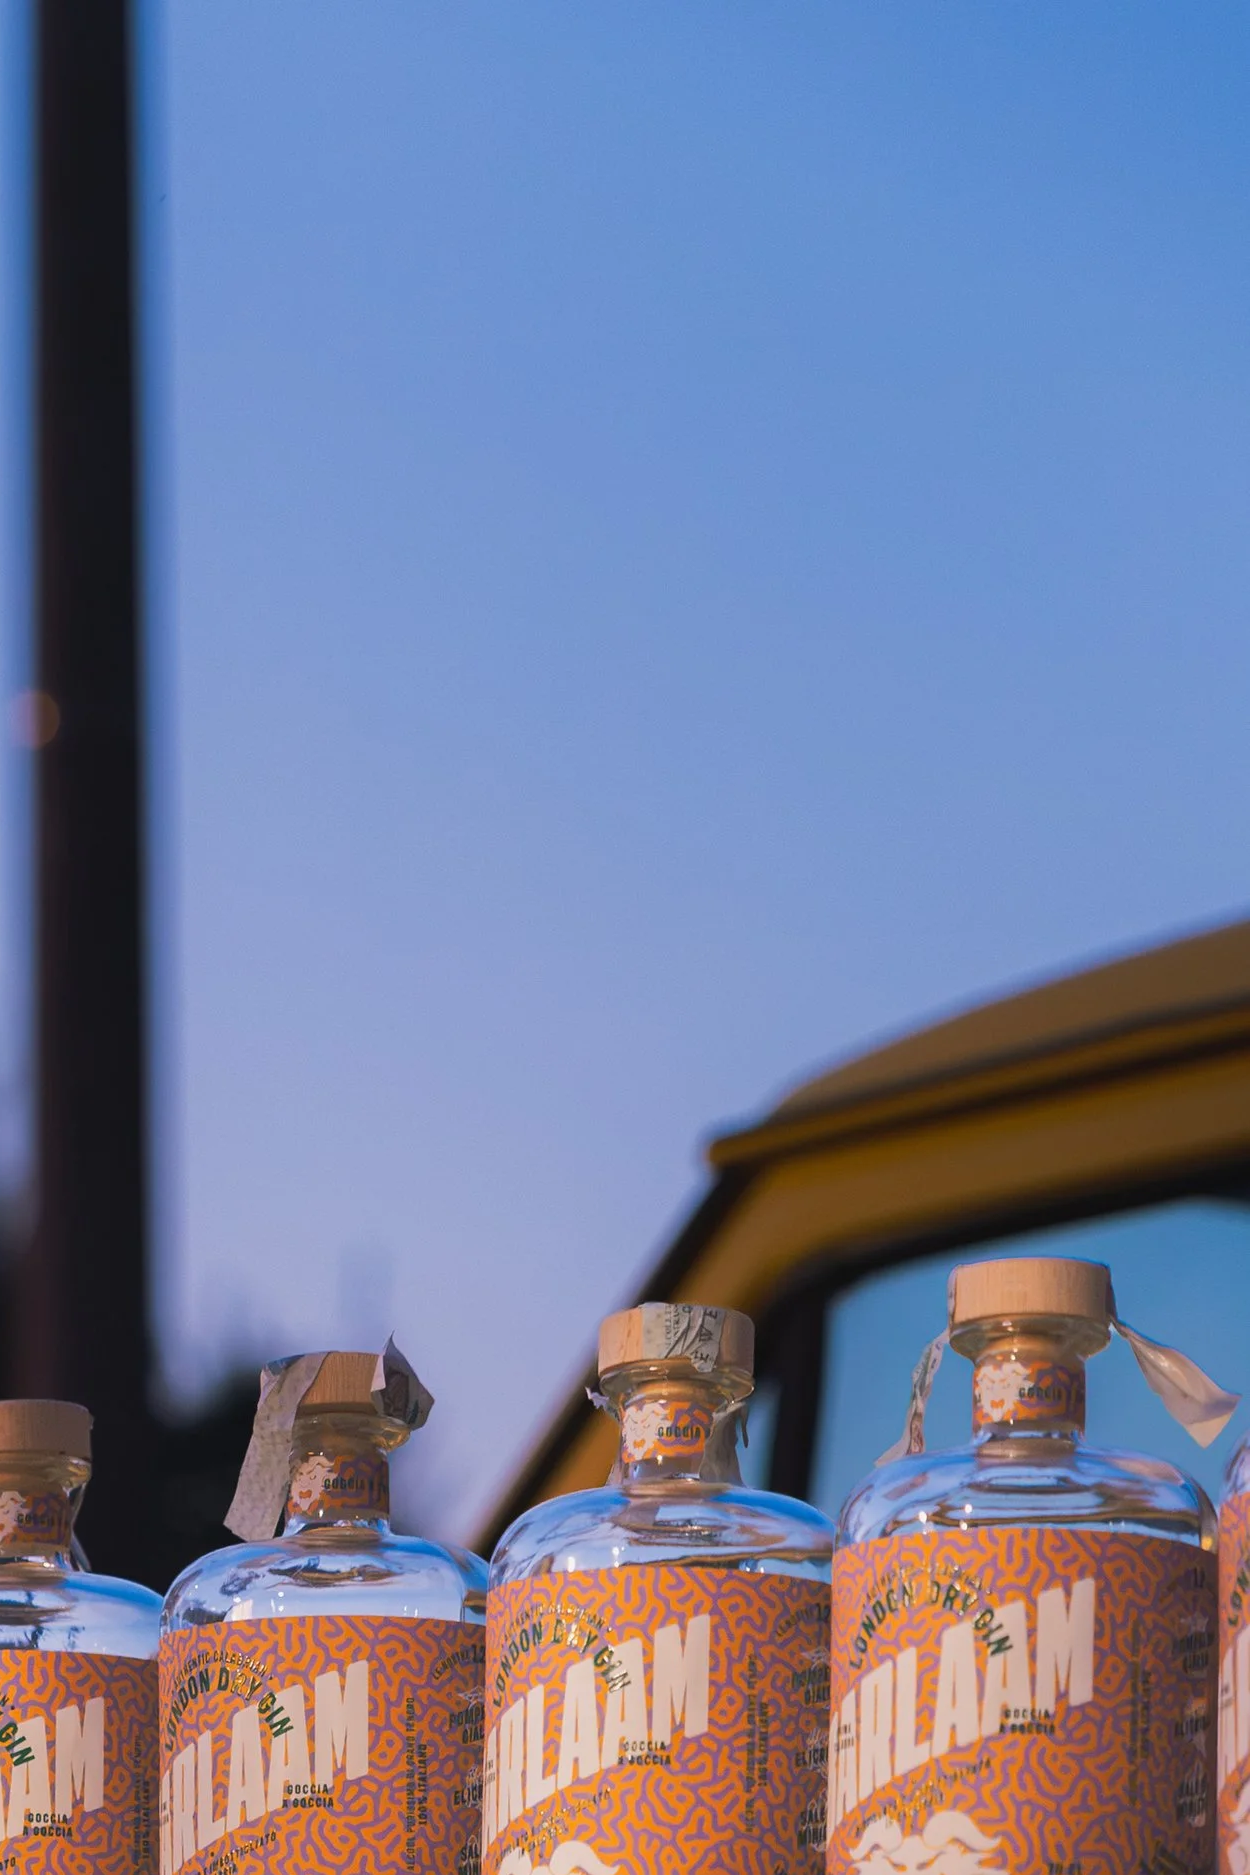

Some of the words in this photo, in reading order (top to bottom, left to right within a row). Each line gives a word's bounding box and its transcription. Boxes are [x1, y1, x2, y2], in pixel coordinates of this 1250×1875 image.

[849, 1583, 914, 1669] LONDON
[931, 1580, 979, 1615] DRY
[973, 1608, 1014, 1658] GIN
[213, 1650, 268, 1679] CALABRIAN
[493, 1622, 543, 1707] LONDON
[165, 1668, 211, 1751] LONDON
[218, 1668, 263, 1702] DRY
[257, 1691, 295, 1740] GIN
[623, 1740, 667, 1751] GOCCIA
[418, 1744, 428, 1794] ITALIANO
[286, 1783, 329, 1796] GOCCIA
[292, 1797, 334, 1809] GOCCIA
[27, 1813, 69, 1825] GOCCIA
[418, 1796, 428, 1826] 100%
[33, 1826, 74, 1837] GOCCIA
